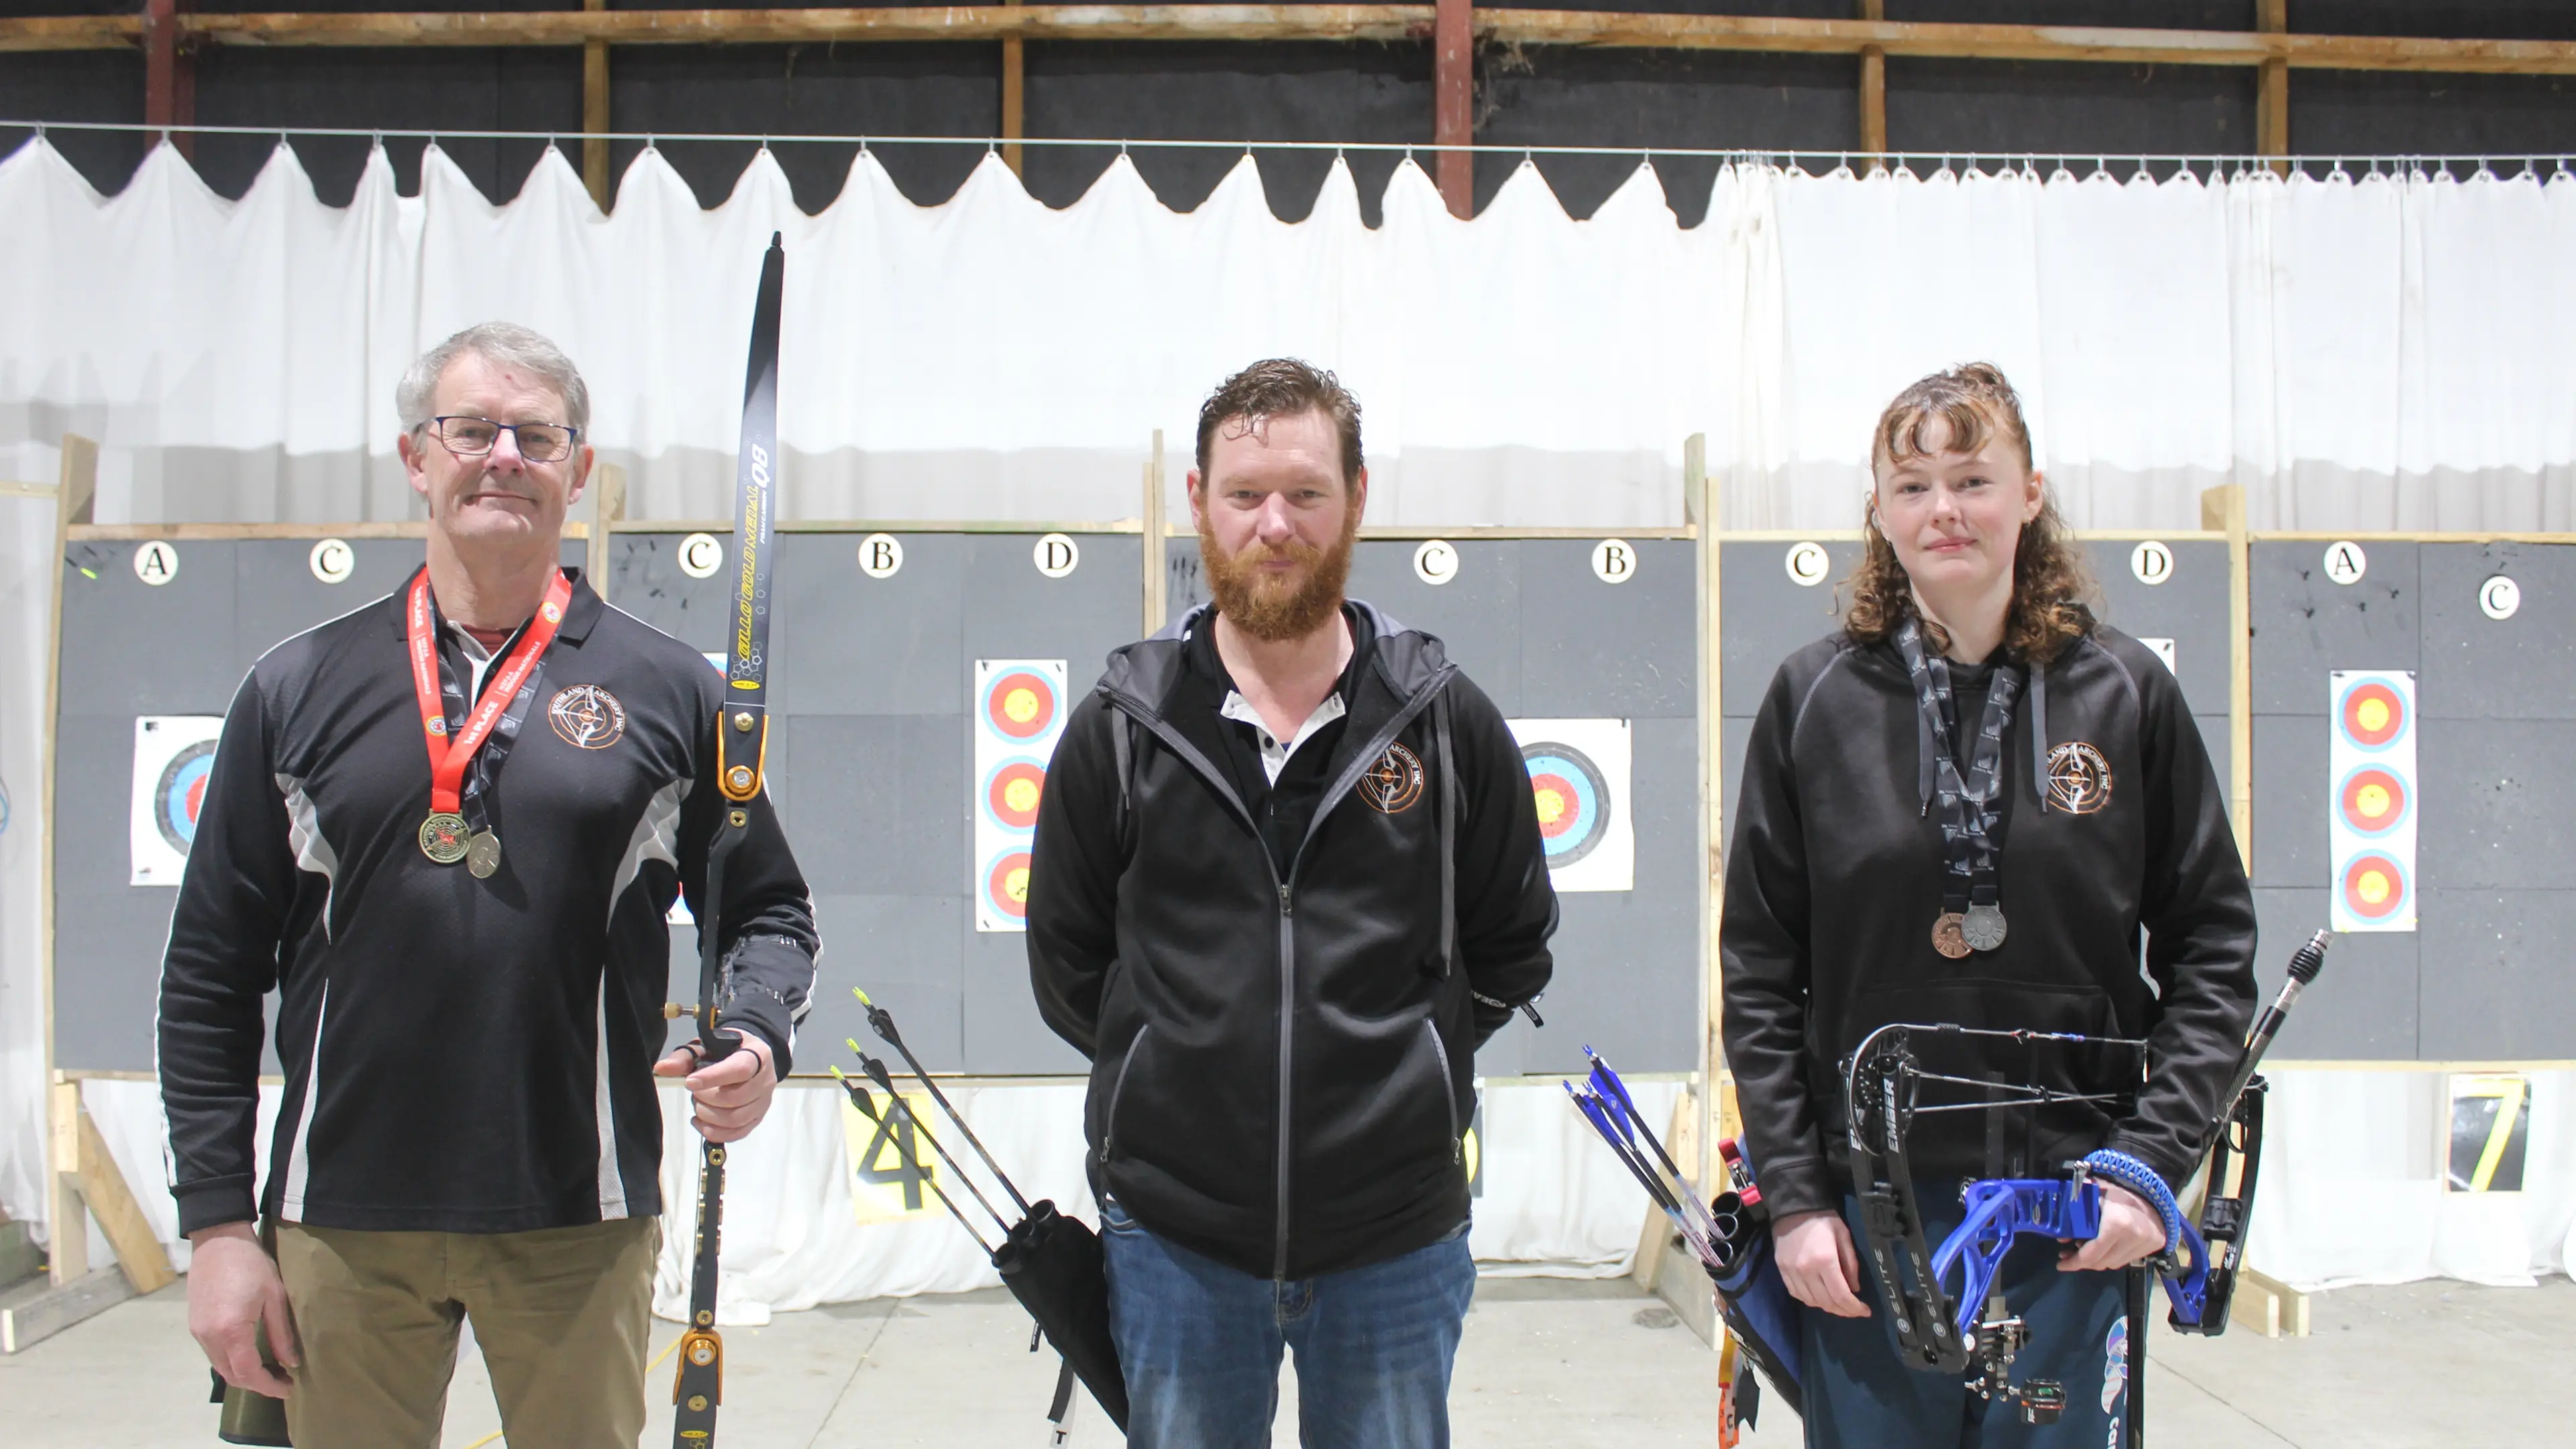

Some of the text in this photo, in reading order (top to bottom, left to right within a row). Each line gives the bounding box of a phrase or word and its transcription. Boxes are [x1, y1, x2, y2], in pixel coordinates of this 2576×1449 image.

[143, 547, 167, 575] A
[319, 547, 341, 574] C
[687, 542, 709, 569] C
[871, 542, 894, 569] B
[1046, 542, 1071, 569] D
[1421, 549, 1444, 576] C
[1604, 547, 1625, 574] B
[1794, 550, 1815, 577] C
[2142, 549, 2165, 576] D
[2334, 547, 2357, 575] A
[738, 485, 759, 661] GILLO GOLD MEDAL
[2489, 584, 2509, 610] C
[517, 641, 541, 673] NATIONALS
[473, 700, 499, 733] PLACE
[551, 686, 623, 732] SOUTHLAND ARCHERY INC
[1389, 743, 1421, 785] ARCHERY INC
[2078, 745, 2107, 773] ARCHERY
[2100, 774, 2108, 790] INC
[1882, 1077, 1900, 1154] EMBER
[2450, 1077, 2525, 1192] 7
[857, 1097, 933, 1211] 4
[1874, 1248, 1901, 1316] ELITE
[1911, 1251, 1938, 1320] ELITE
